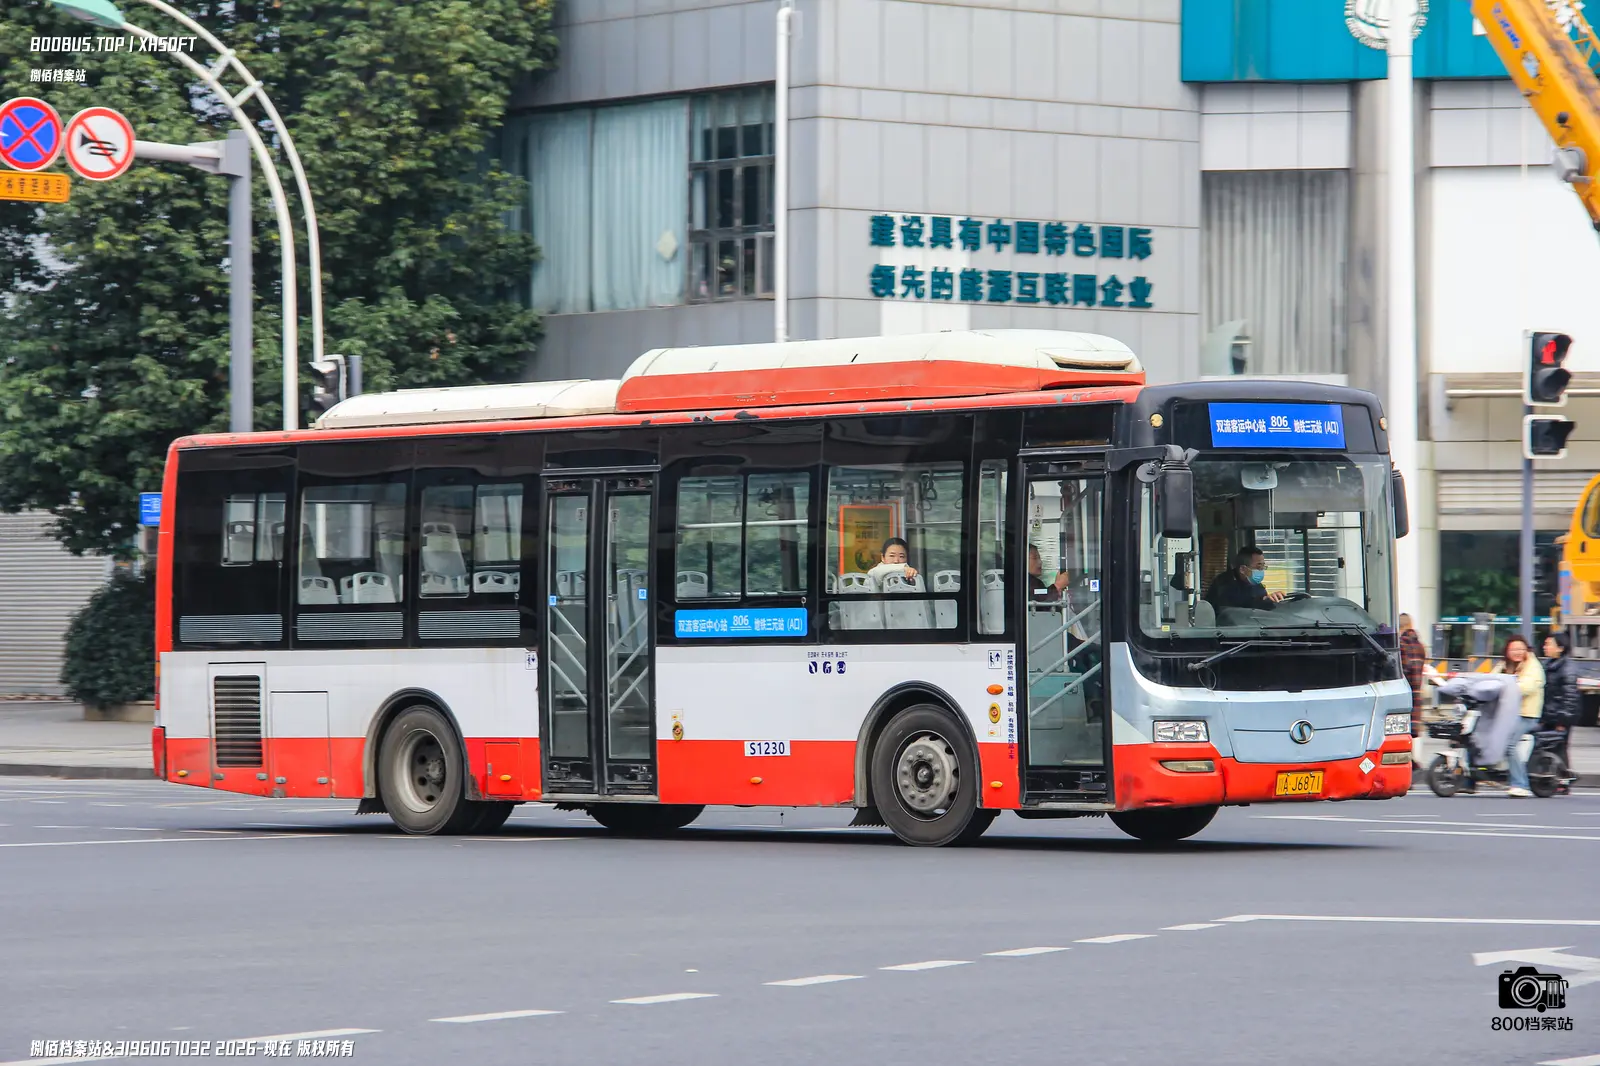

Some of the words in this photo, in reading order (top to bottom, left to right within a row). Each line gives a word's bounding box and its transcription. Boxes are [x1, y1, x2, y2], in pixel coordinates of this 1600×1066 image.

[869, 214, 1152, 260] 建设具有中国特色国际
[869, 264, 1153, 308] 领先的能源互联网企业
[1216, 419, 1266, 433] 双流客运中心站
[1270, 415, 1288, 427] 806
[678, 618, 728, 632] 双流客运中心站
[732, 615, 749, 626] 806
[750, 742, 785, 755] S1230
